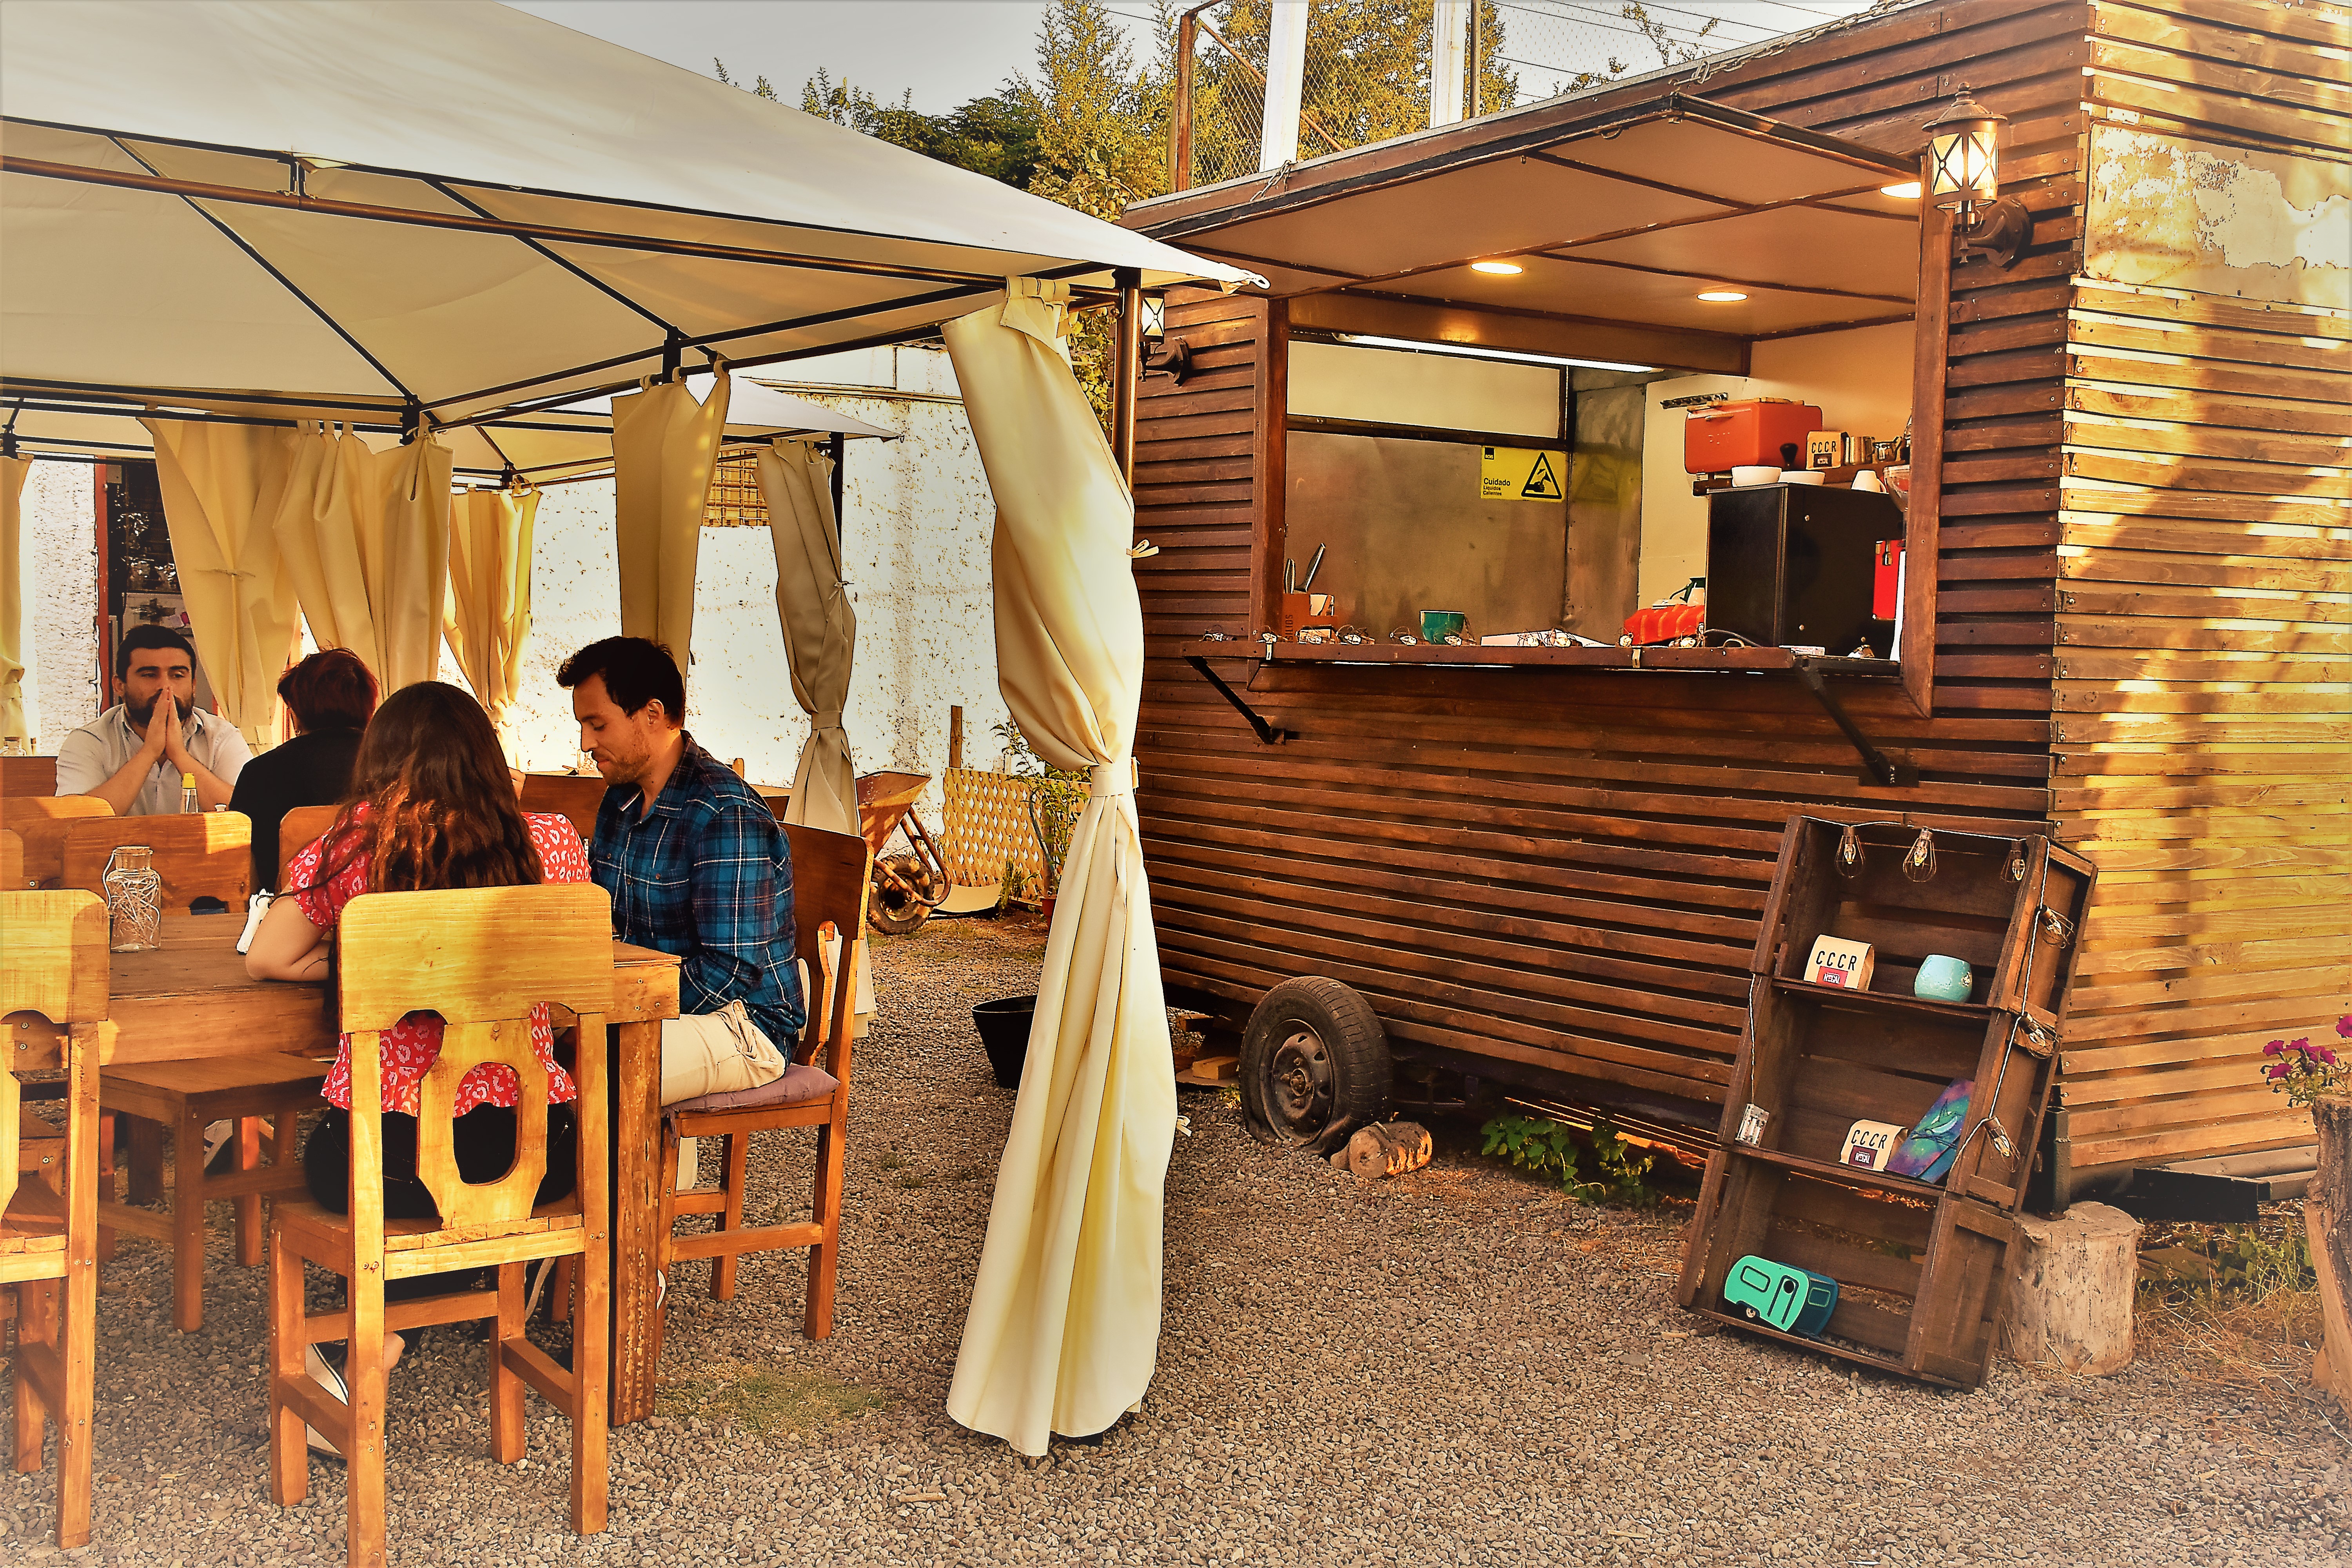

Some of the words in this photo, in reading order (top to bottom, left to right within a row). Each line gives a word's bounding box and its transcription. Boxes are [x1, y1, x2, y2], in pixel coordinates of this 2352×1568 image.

[1812, 441, 1837, 453] CCCR
[1484, 477, 1510, 486] Cuidado
[1816, 951, 1857, 971] CCCR
[1851, 1129, 1888, 1149] CCCR
